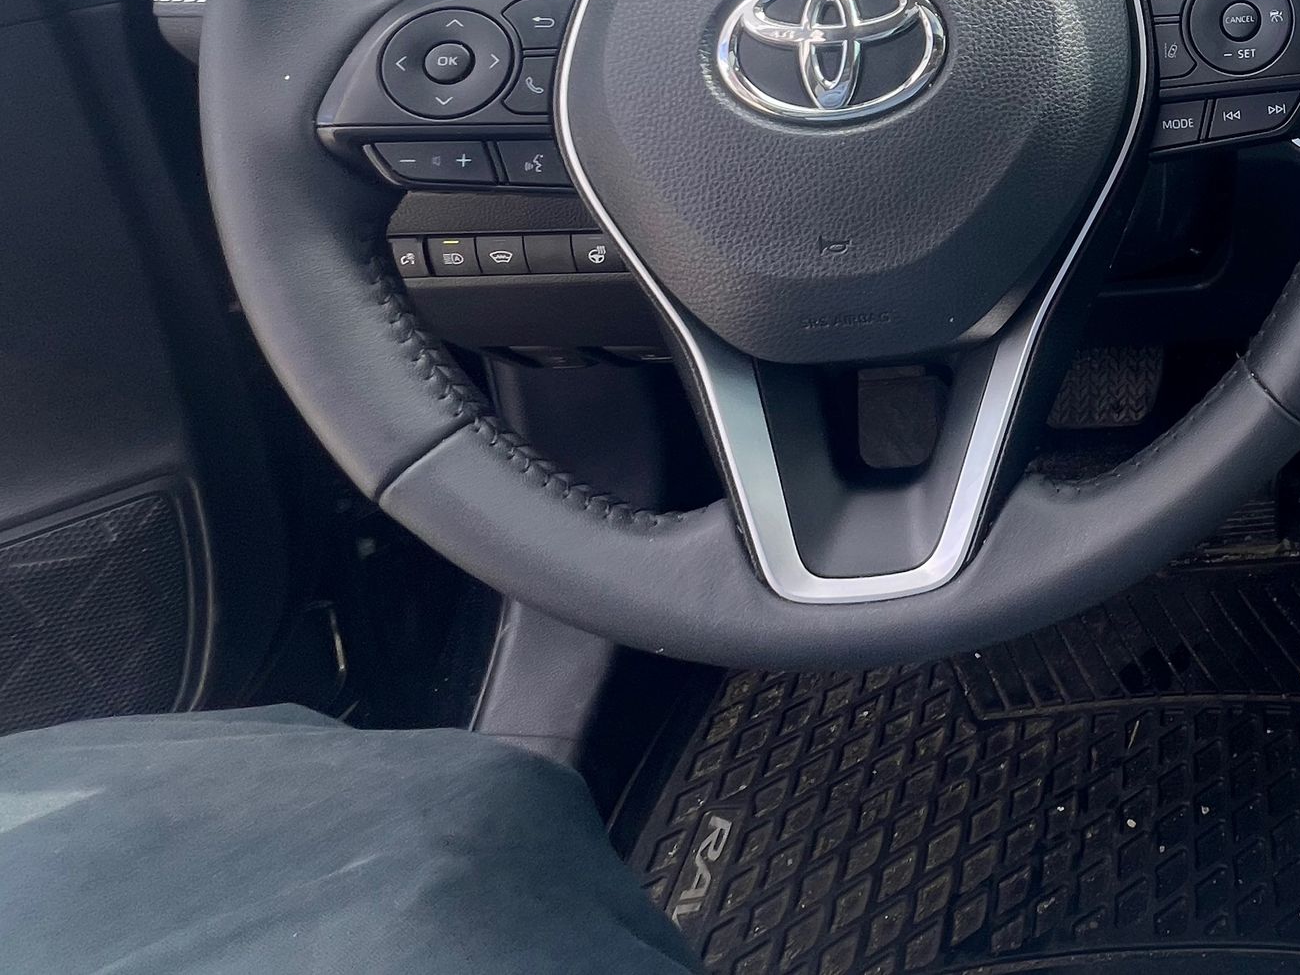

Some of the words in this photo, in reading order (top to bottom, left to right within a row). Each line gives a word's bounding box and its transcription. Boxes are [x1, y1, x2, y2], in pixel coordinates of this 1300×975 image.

[1225, 15, 1255, 24] CANCEL
[1237, 49, 1256, 59] SET
[437, 56, 458, 67] OK
[1162, 118, 1194, 130] MODE
